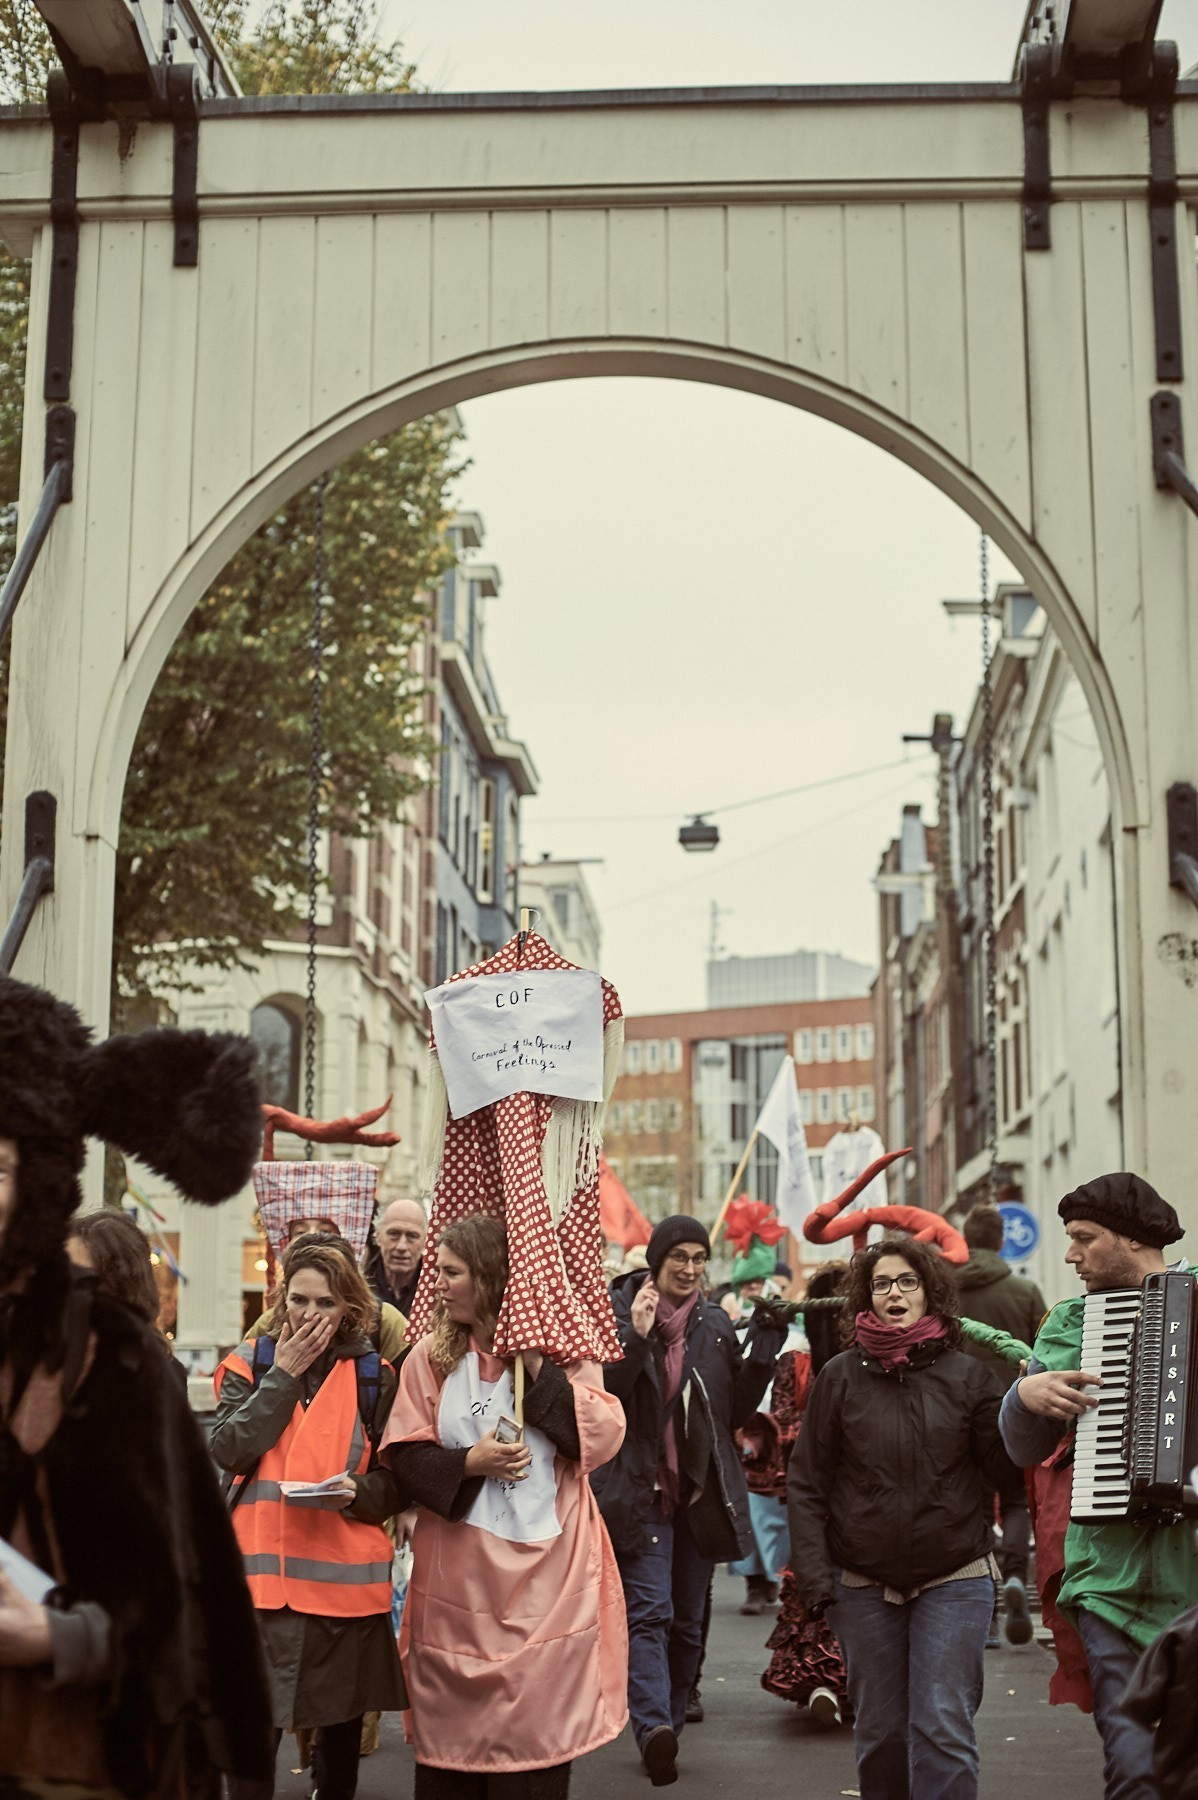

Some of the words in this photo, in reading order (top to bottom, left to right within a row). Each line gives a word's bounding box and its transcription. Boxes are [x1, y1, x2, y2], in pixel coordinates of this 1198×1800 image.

[495, 988, 534, 1008] COF
[512, 1040, 520, 1054] of
[496, 1053, 557, 1074] Feelings
[1163, 1321, 1180, 1450] FISART
